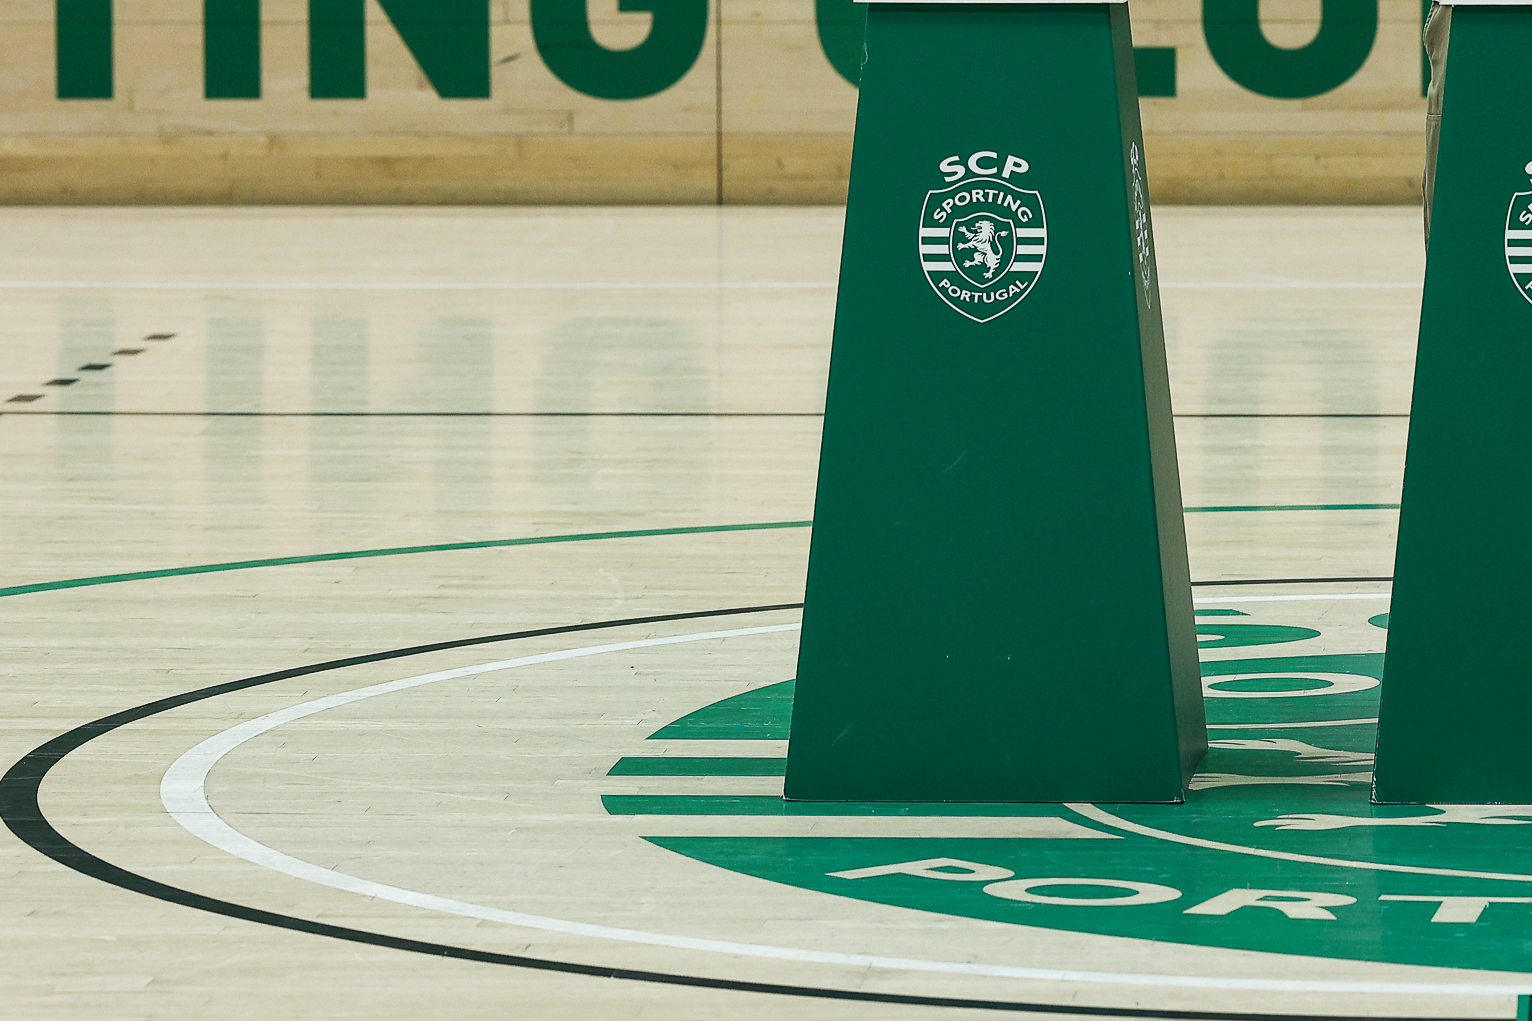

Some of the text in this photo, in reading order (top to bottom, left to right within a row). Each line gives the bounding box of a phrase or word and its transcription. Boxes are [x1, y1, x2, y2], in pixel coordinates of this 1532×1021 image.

[938, 150, 1030, 183] SCP
[933, 189, 1033, 223] SPORTING
[938, 278, 1028, 304] PORTUGAL
